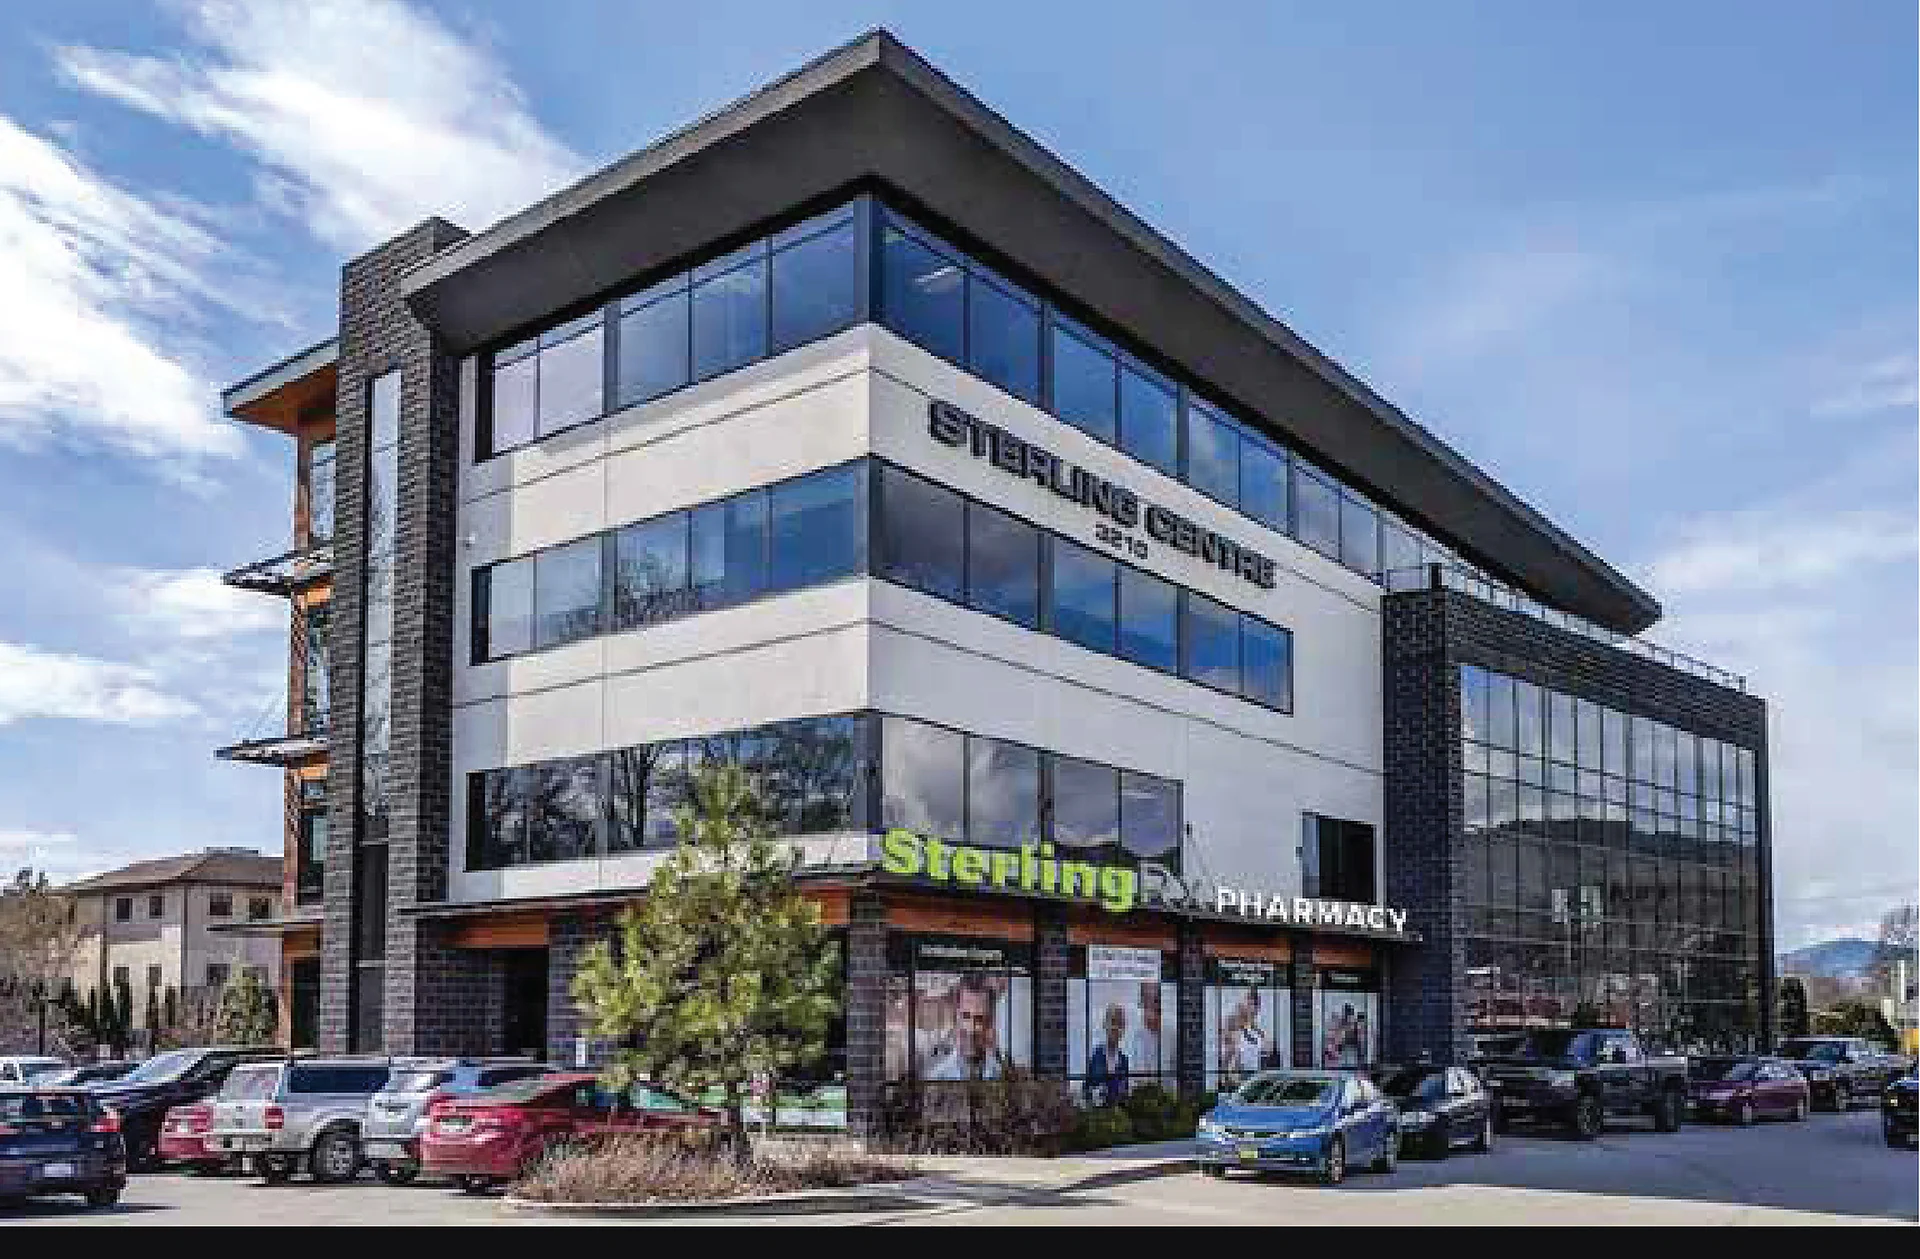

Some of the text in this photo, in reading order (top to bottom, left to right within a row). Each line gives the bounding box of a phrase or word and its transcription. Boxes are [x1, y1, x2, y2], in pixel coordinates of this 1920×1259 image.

[928, 399, 1277, 589] STERLING CENTRE
[880, 827, 1139, 913] Sterling
[1216, 885, 1407, 932] PHARMACY
